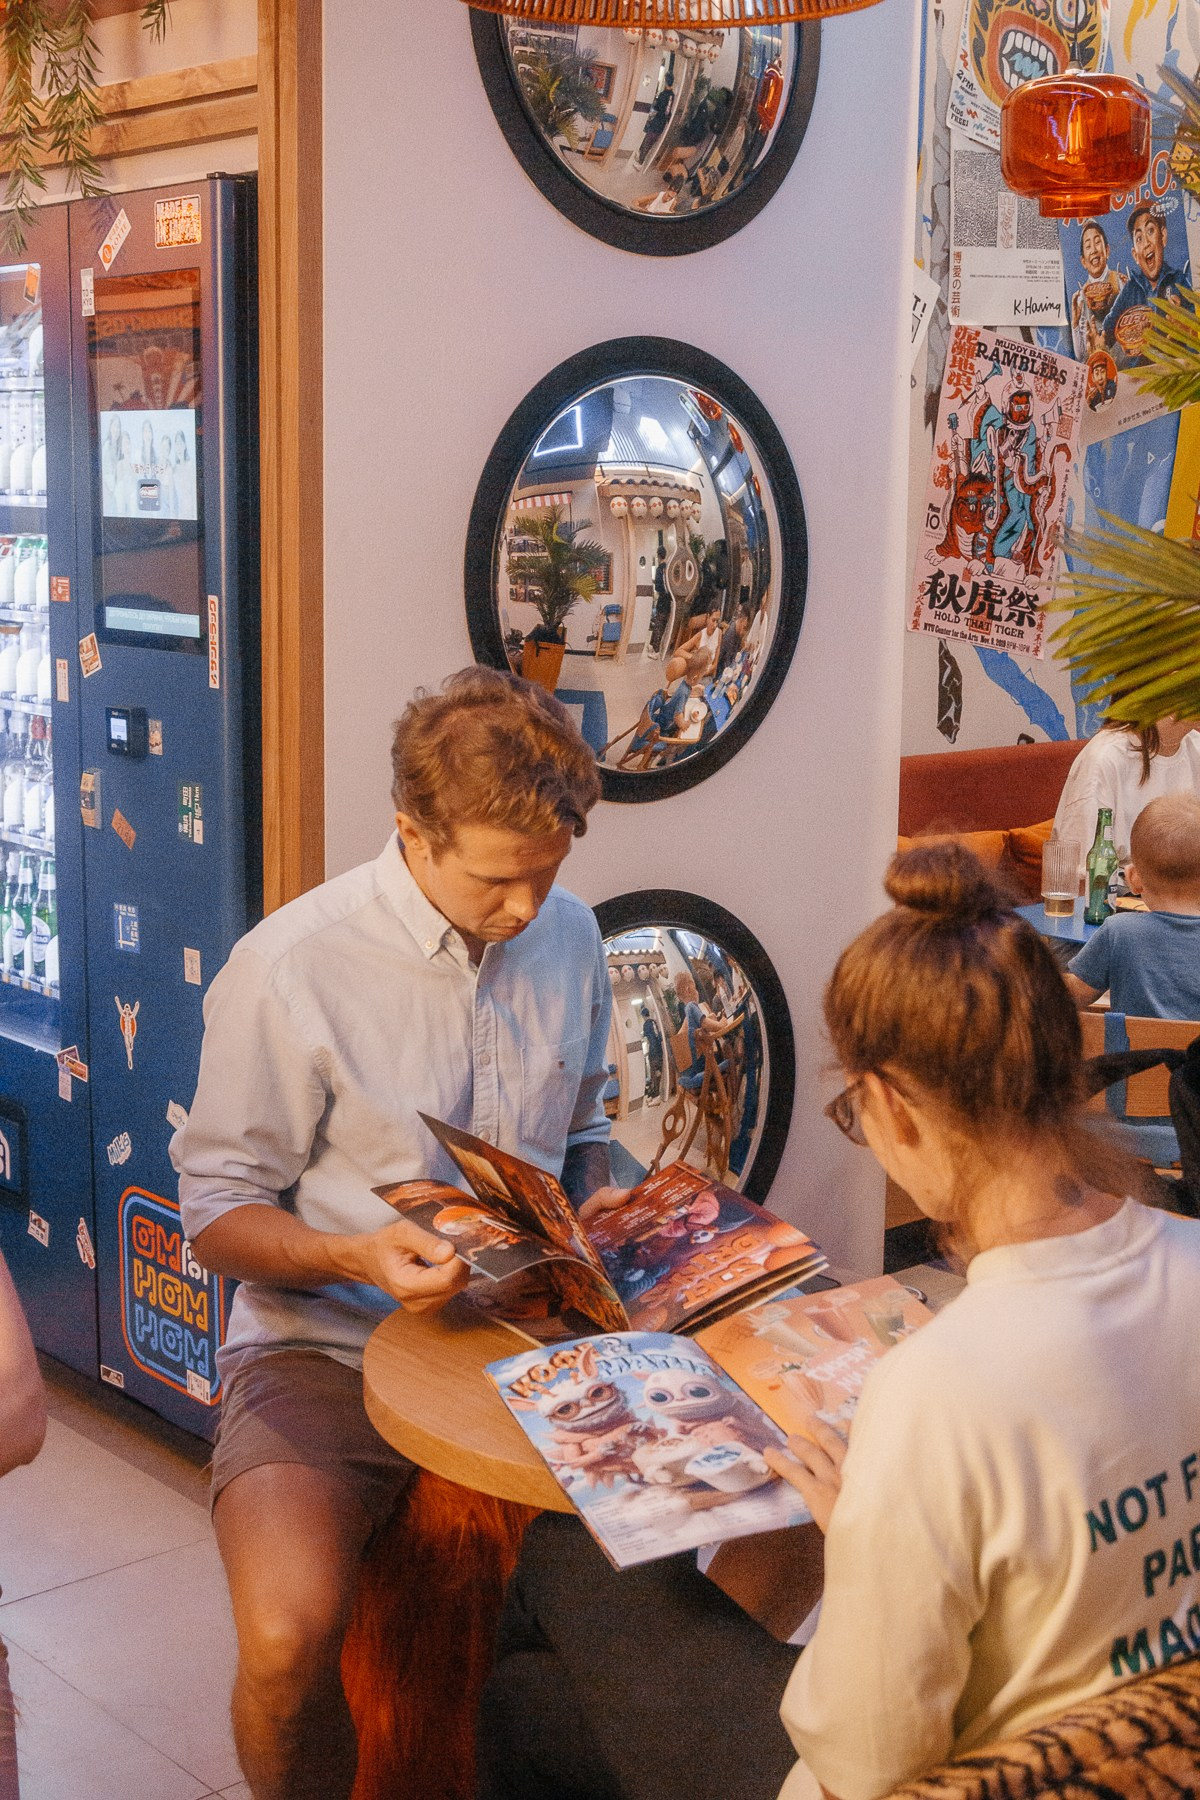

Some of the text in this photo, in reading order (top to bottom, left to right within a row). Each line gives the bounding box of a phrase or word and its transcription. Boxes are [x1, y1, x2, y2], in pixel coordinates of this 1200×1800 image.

[950, 102, 964, 117] KIDS
[951, 251, 962, 318] 博愛の芸術
[975, 341, 1068, 386] RAMBLERS
[995, 338, 1028, 355] MUDDY
[1029, 349, 1058, 365] BASIN
[923, 568, 1040, 628] 秋虎祭
[934, 610, 1025, 639] HOLD THAT TIGER
[935, 624, 950, 636] Center
[951, 628, 960, 637] for
[960, 630, 968, 640] the
[968, 631, 979, 642] Arts
[1085, 1470, 1168, 1553] NOT
